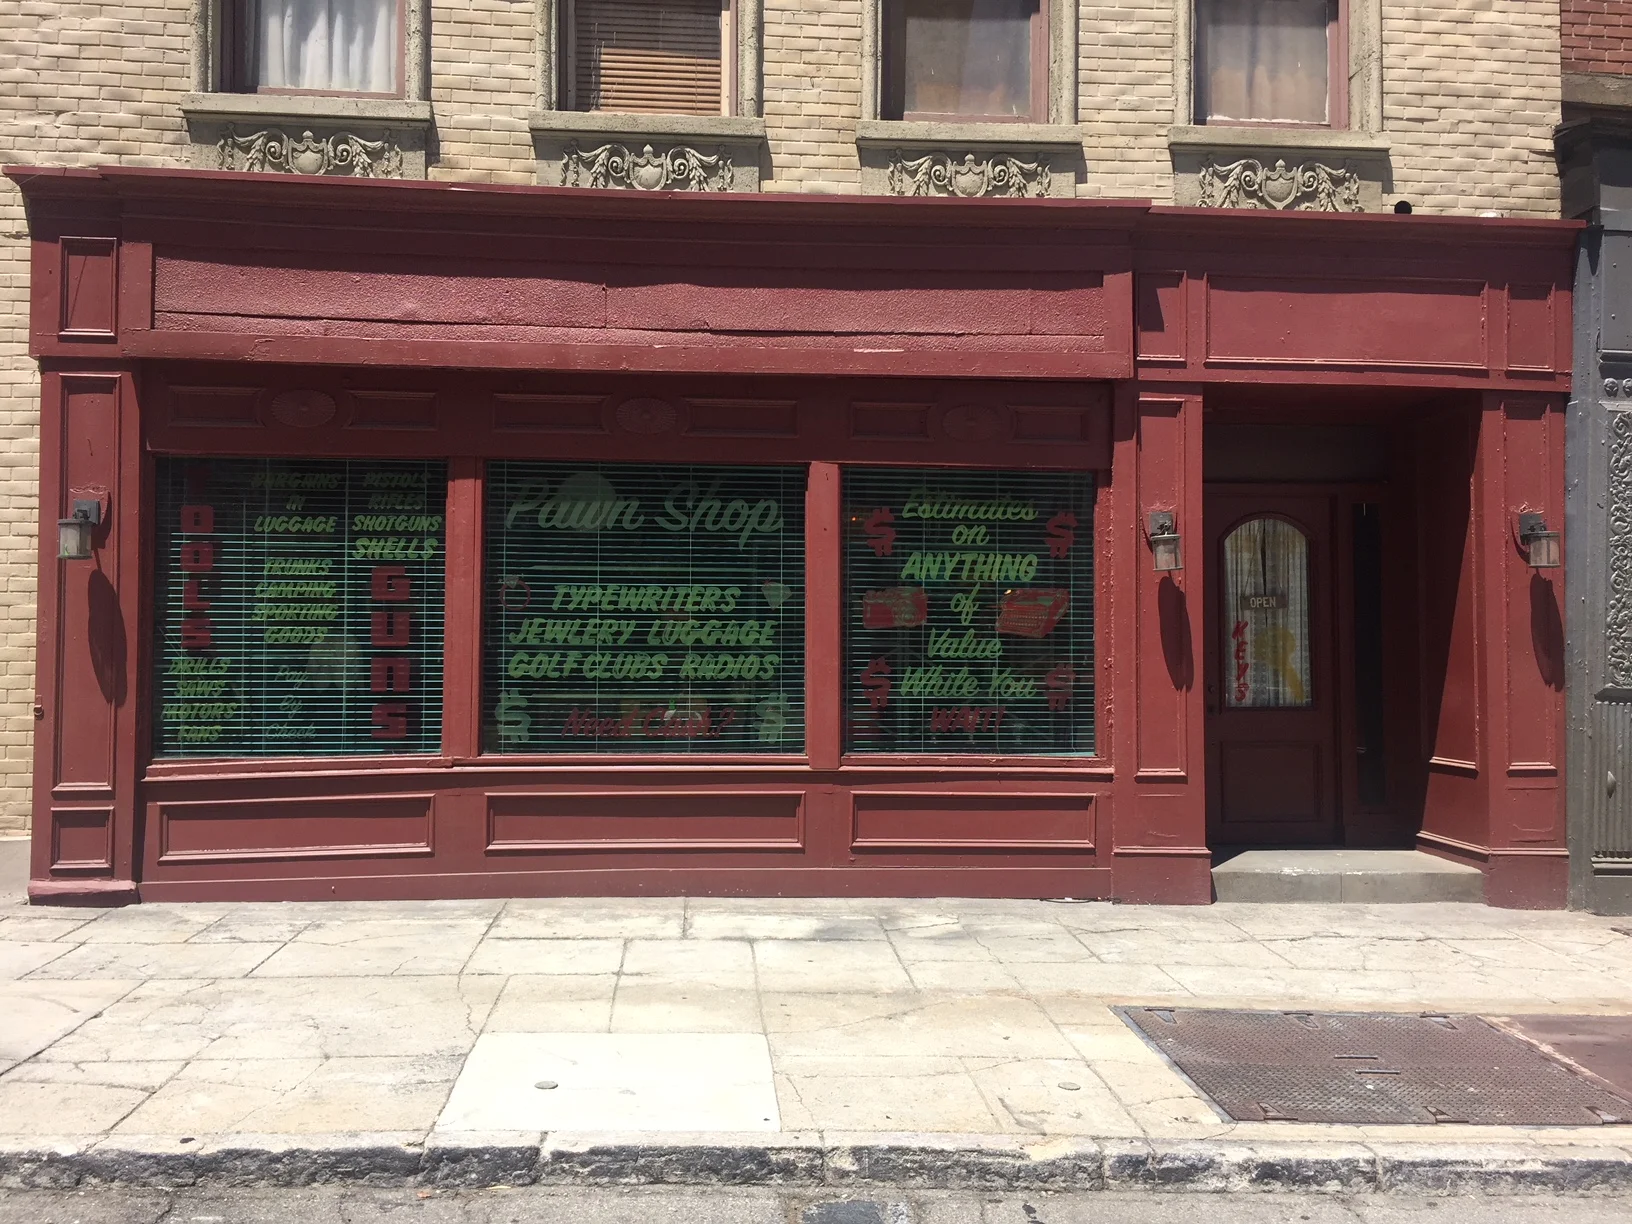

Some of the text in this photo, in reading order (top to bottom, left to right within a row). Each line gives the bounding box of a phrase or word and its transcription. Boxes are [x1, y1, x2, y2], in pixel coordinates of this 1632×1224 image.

[250, 472, 342, 489] BARGAINS
[363, 472, 431, 488] PISTOLS
[286, 493, 305, 511] IN
[368, 493, 424, 510] RIFLES
[902, 488, 1039, 520] Estimates
[254, 515, 338, 532] LUGGAGE
[352, 515, 442, 531] SHOTGUNS
[505, 476, 785, 553] Pawn Shop
[951, 524, 990, 546] on
[351, 538, 438, 560] SHELLS
[263, 559, 332, 576] TRUNKS
[901, 551, 1038, 582] ANYTHING
[254, 581, 337, 598] CAMPING
[550, 584, 741, 612] TYPEWRITERS
[251, 604, 339, 621] SPORTING
[950, 582, 980, 625] of
[1250, 597, 1276, 608] OPEN
[264, 627, 328, 643] GOODS
[508, 618, 779, 646] JEWLERY LUGGAGE
[928, 628, 1003, 659] Value
[168, 658, 231, 675] DRILLS
[508, 652, 780, 680] GOLF CLUBS RADIOS
[1232, 620, 1249, 702] KEYS
[174, 680, 226, 697] SAWS
[275, 667, 309, 691] Pay
[900, 664, 1037, 697] While You
[161, 702, 237, 720] MOTORS
[279, 694, 303, 719] By
[561, 707, 639, 738] Need
[930, 706, 1006, 732] WAIT!
[177, 725, 223, 742] FANS
[265, 722, 316, 741] Check
